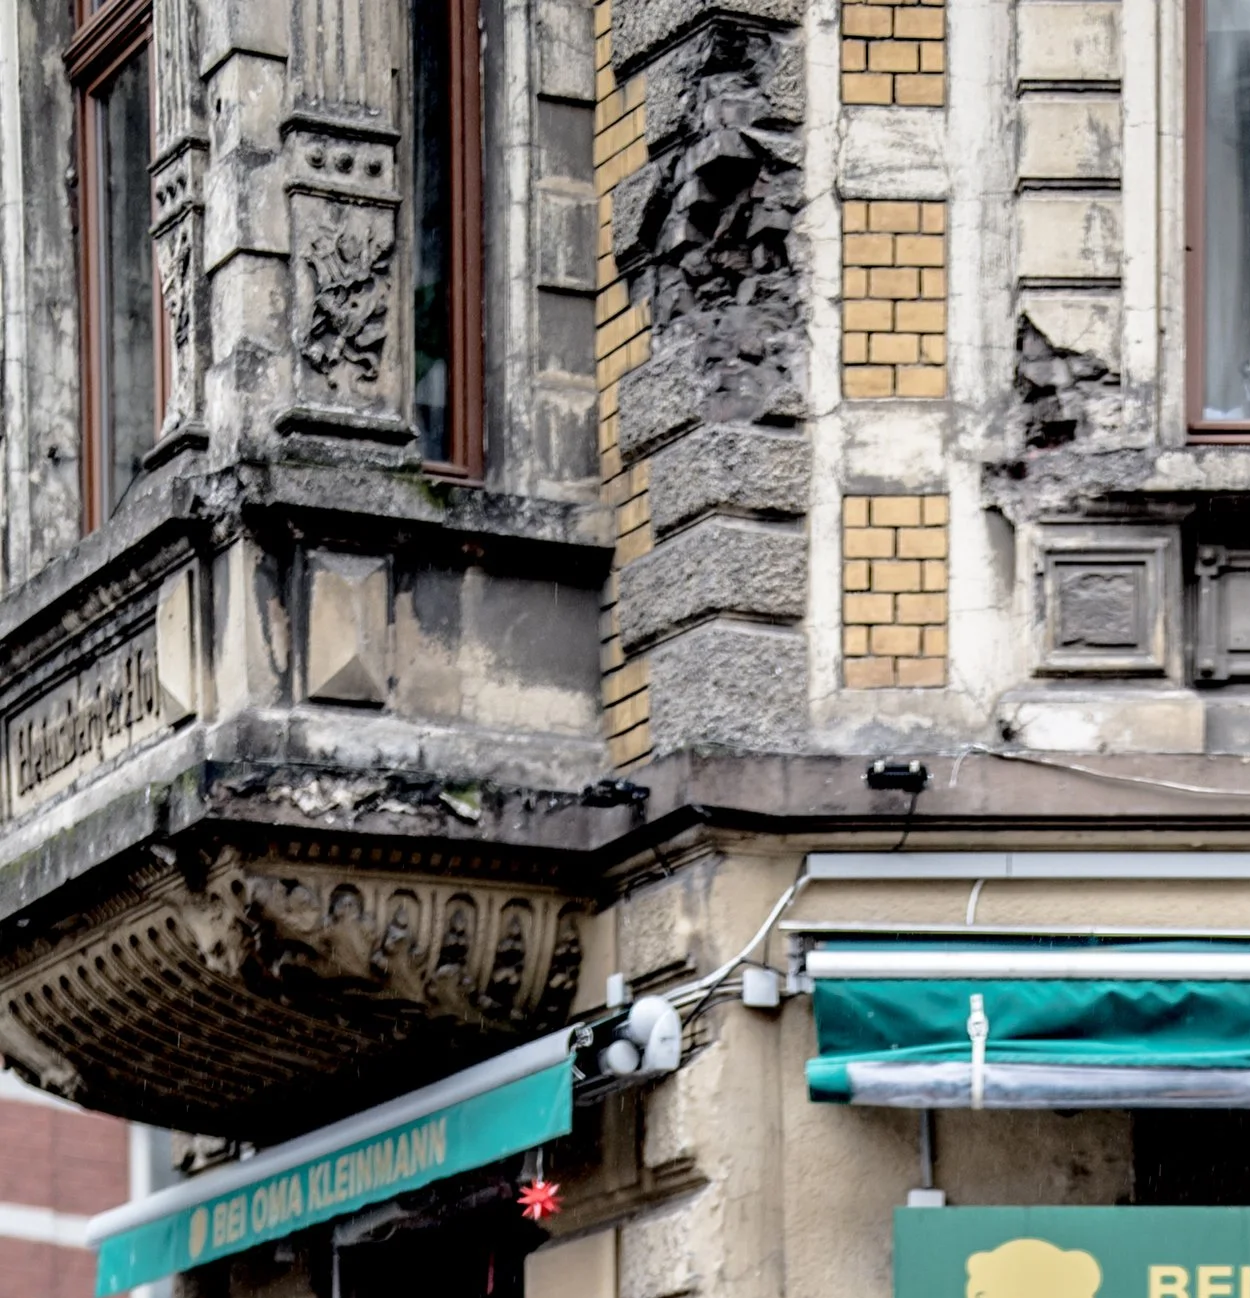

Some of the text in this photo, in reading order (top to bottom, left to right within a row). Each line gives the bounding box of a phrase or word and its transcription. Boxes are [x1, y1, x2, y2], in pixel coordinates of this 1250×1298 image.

[213, 1117, 447, 1249] BEI OMA KLEINMANN
